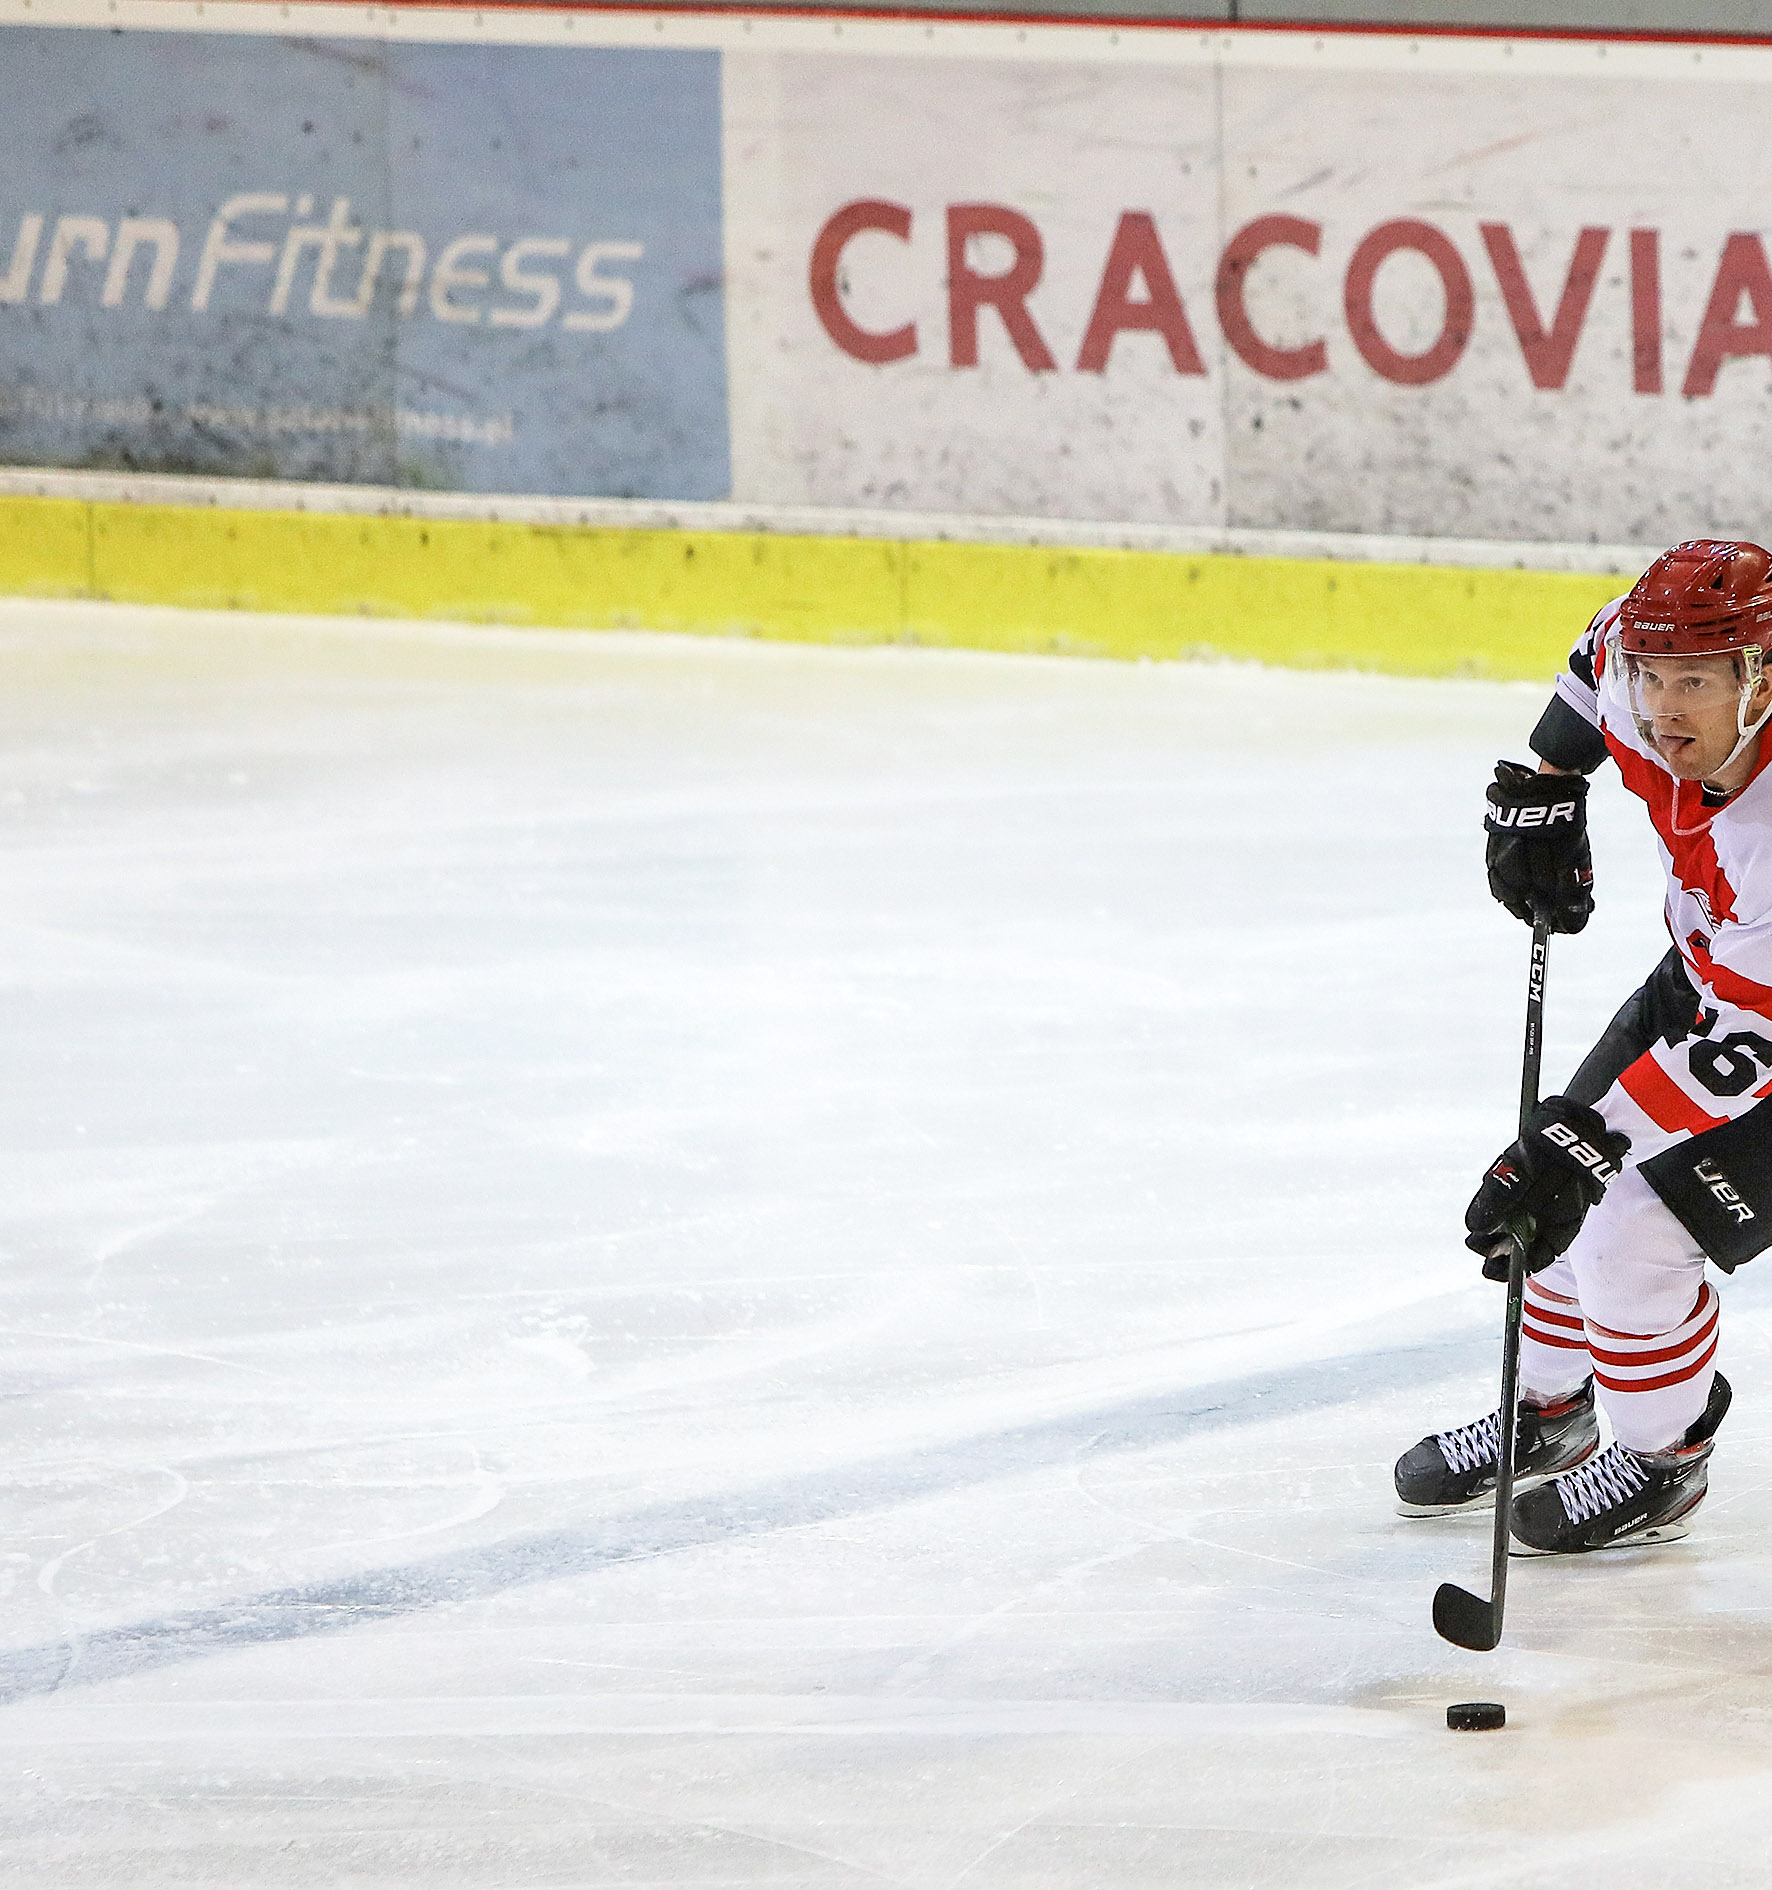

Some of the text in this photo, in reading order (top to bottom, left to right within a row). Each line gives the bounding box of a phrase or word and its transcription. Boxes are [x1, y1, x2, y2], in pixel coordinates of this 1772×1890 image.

[191, 193, 645, 331] Fitness
[1633, 620, 1676, 632] BAUER
[1529, 942, 1546, 1004] CCM
